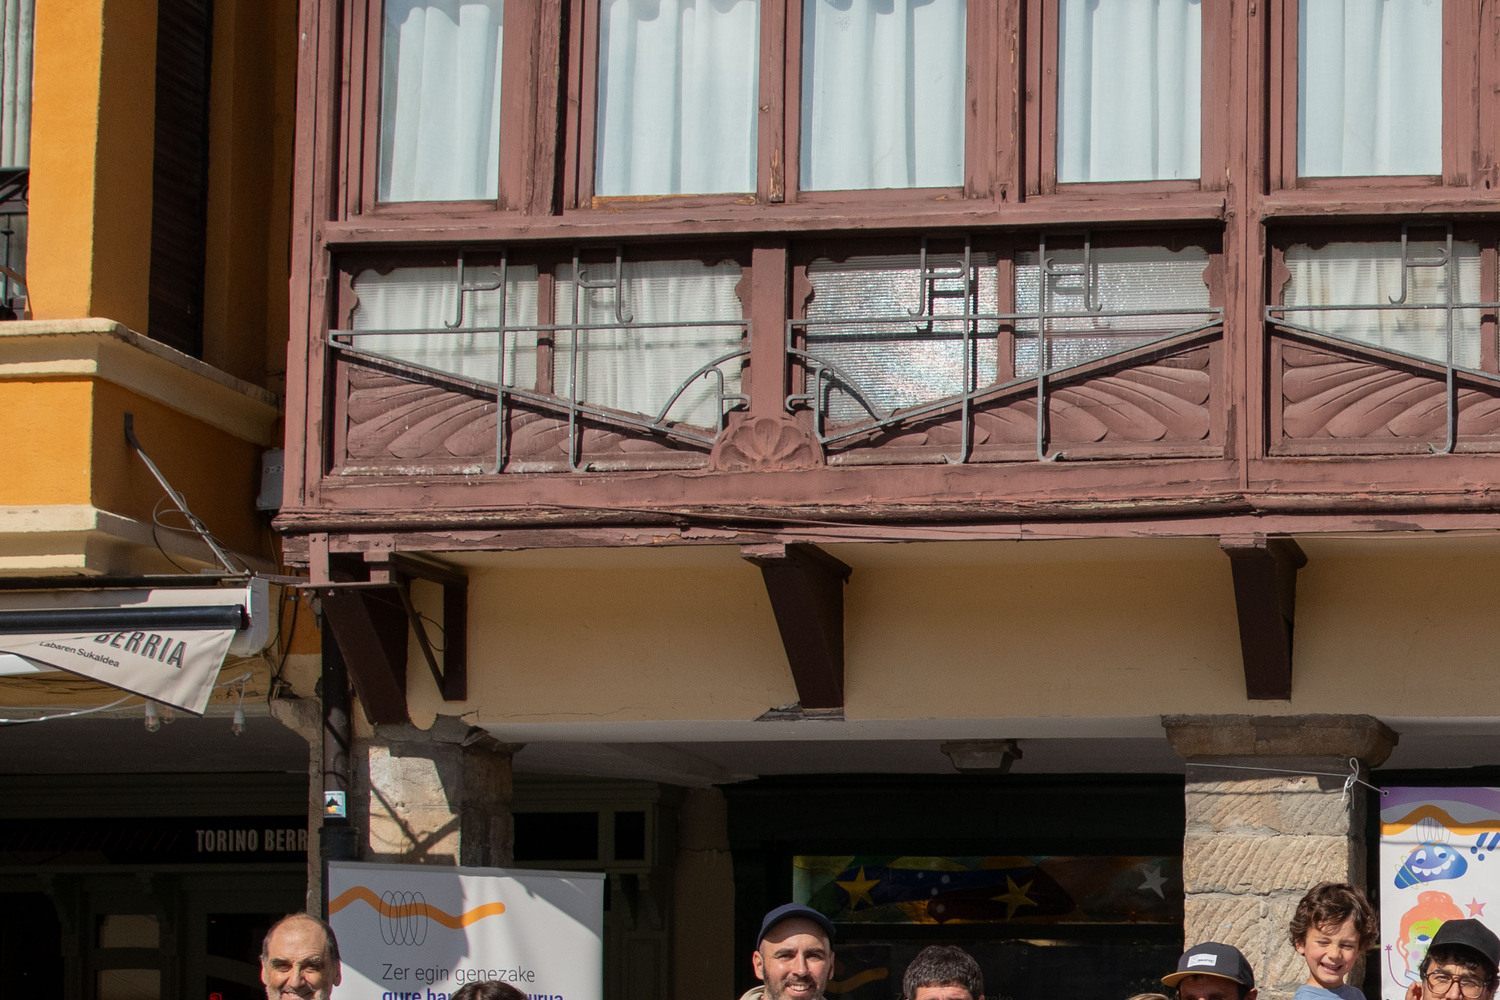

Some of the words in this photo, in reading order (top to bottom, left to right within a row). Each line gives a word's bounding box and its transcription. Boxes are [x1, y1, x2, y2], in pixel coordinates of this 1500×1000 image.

[39, 641, 77, 655] Labaren
[76, 648, 120, 668] Sukaldea
[195, 829, 259, 852] TORINO
[264, 828, 309, 852] BERR
[382, 963, 410, 981] Zer
[415, 964, 449, 986] egin
[455, 965, 536, 986] genezake
